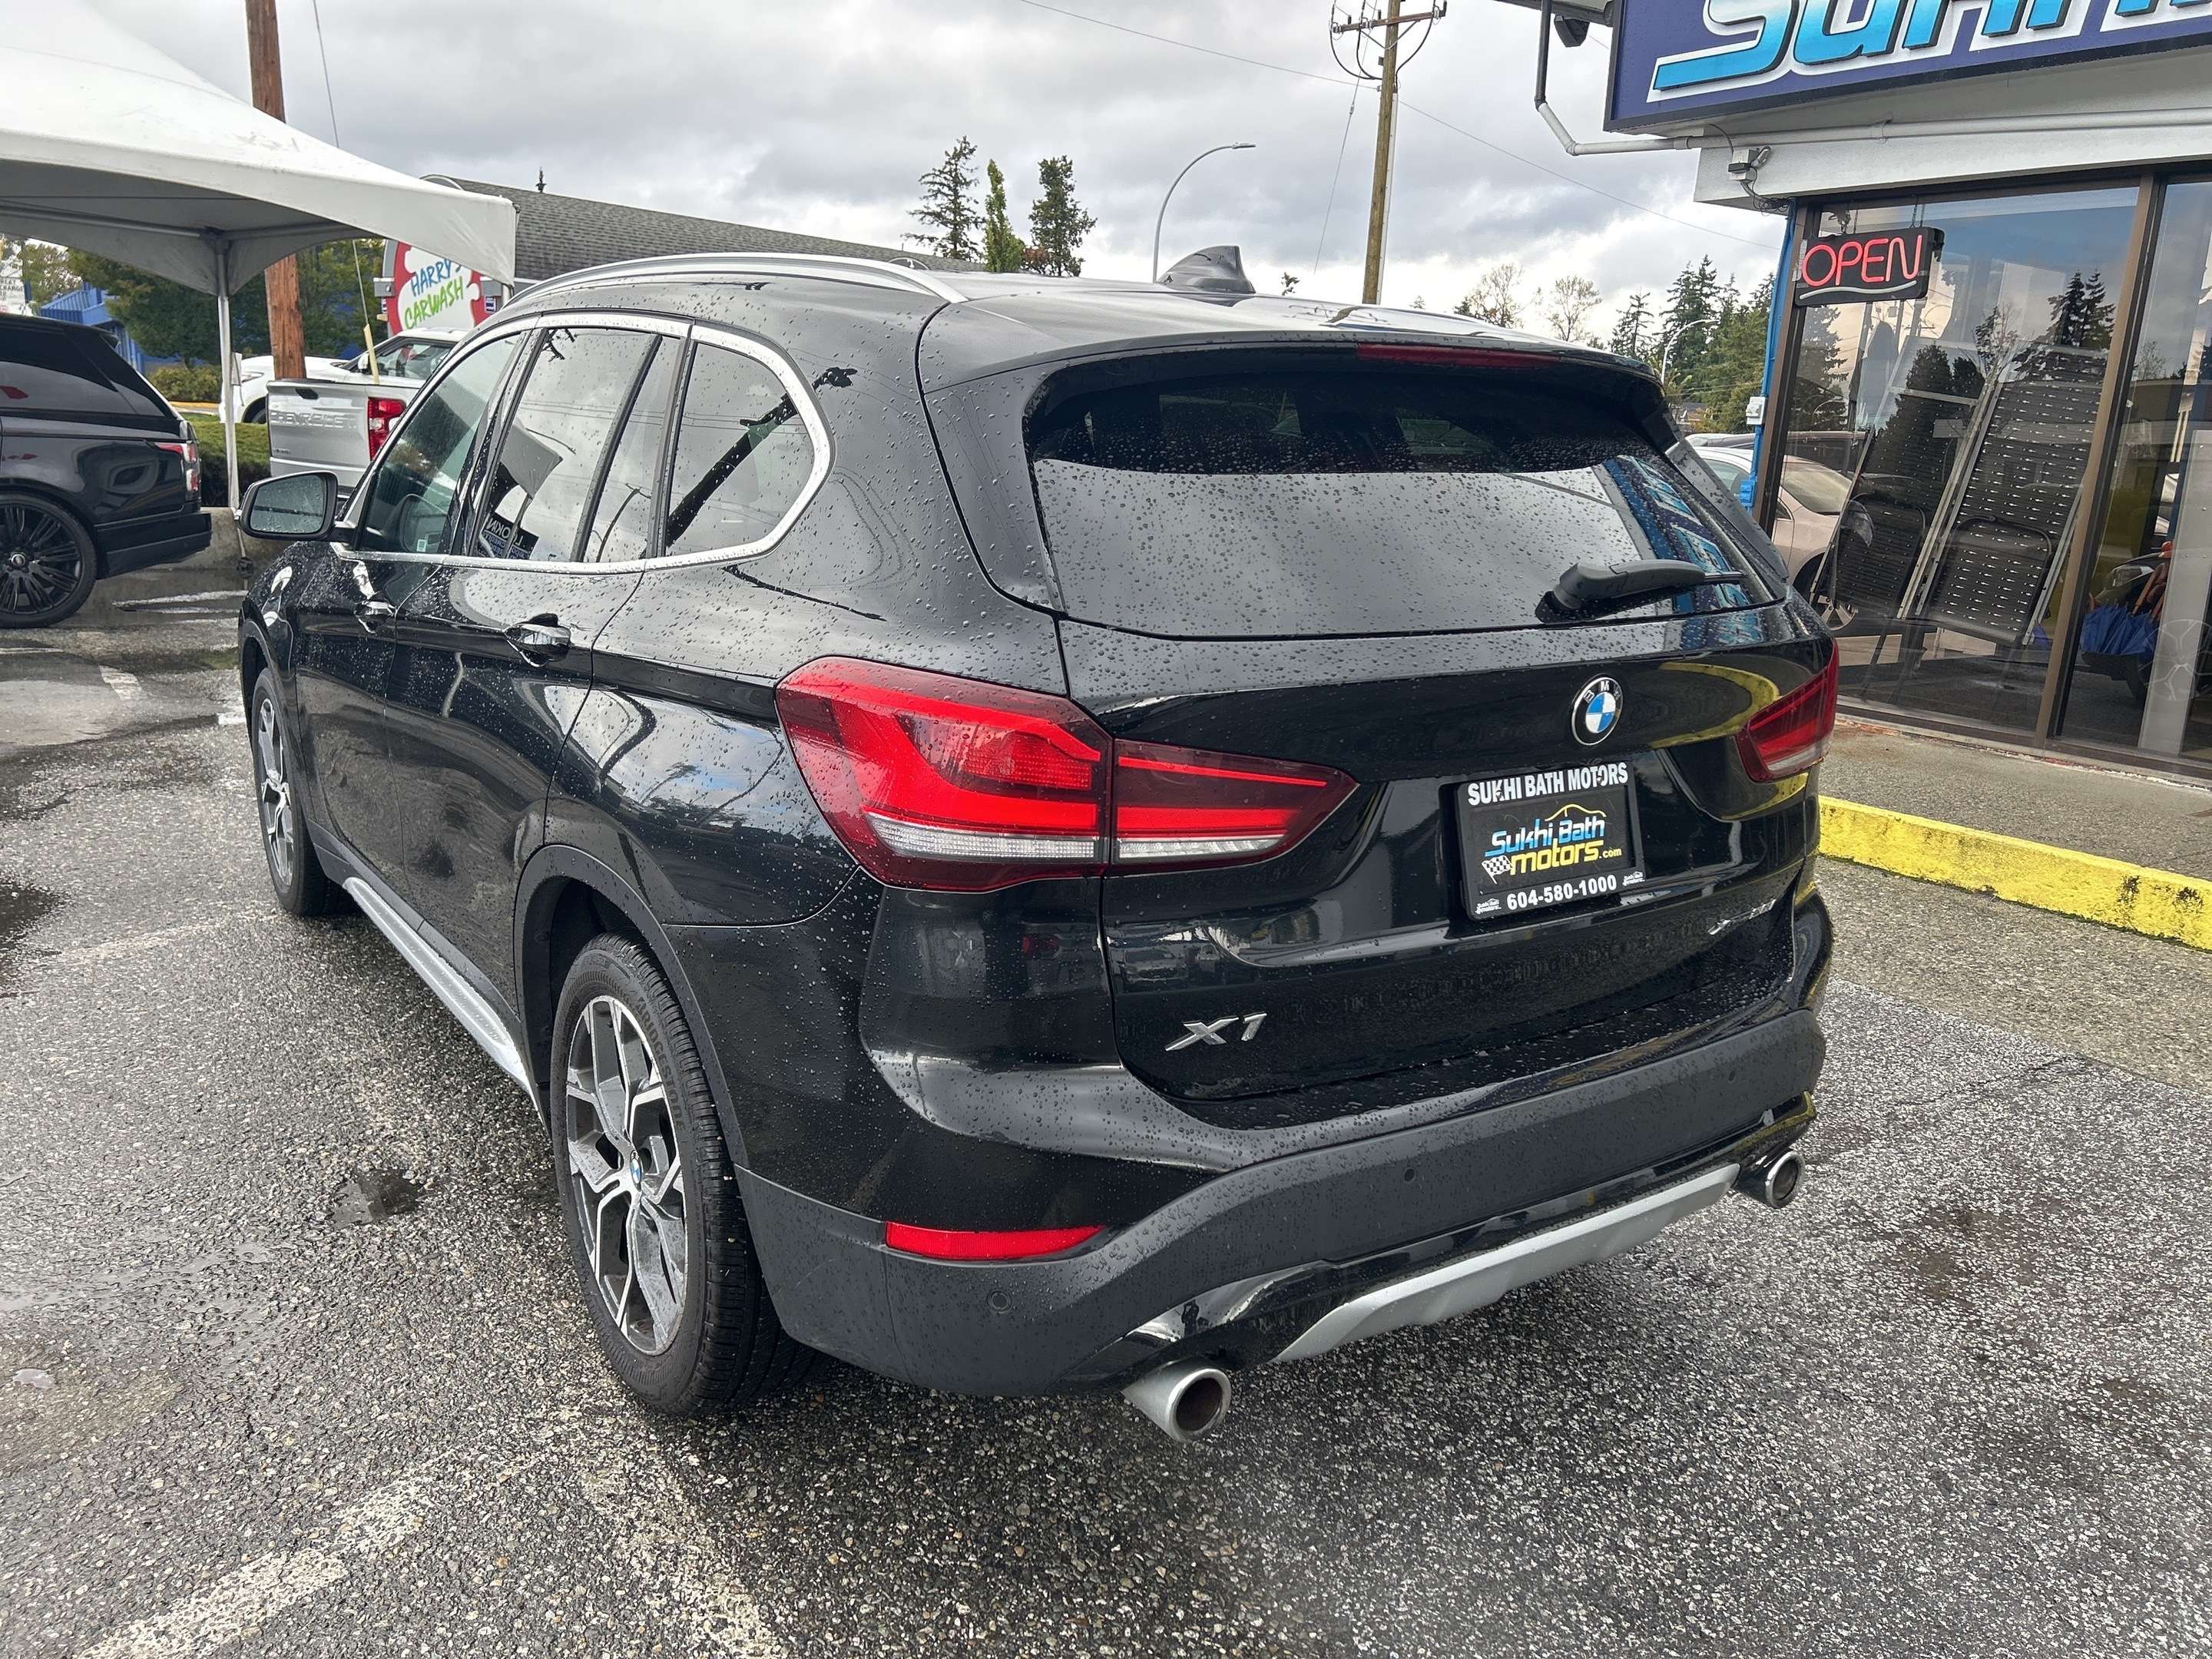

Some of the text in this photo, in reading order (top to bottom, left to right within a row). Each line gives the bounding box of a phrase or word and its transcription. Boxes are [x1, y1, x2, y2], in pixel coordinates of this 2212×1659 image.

[411, 258, 462, 297] HARRY
[1802, 235, 1922, 287] OPEN
[405, 276, 464, 329] CARWASH
[1583, 680, 1621, 704] BMW
[1468, 762, 1628, 806] SUKHI BATH MOTORS
[1485, 816, 1605, 857] Sukhi Bath
[1506, 874, 1617, 910] 604-580-1000
[1165, 1012, 1267, 1051] X1
